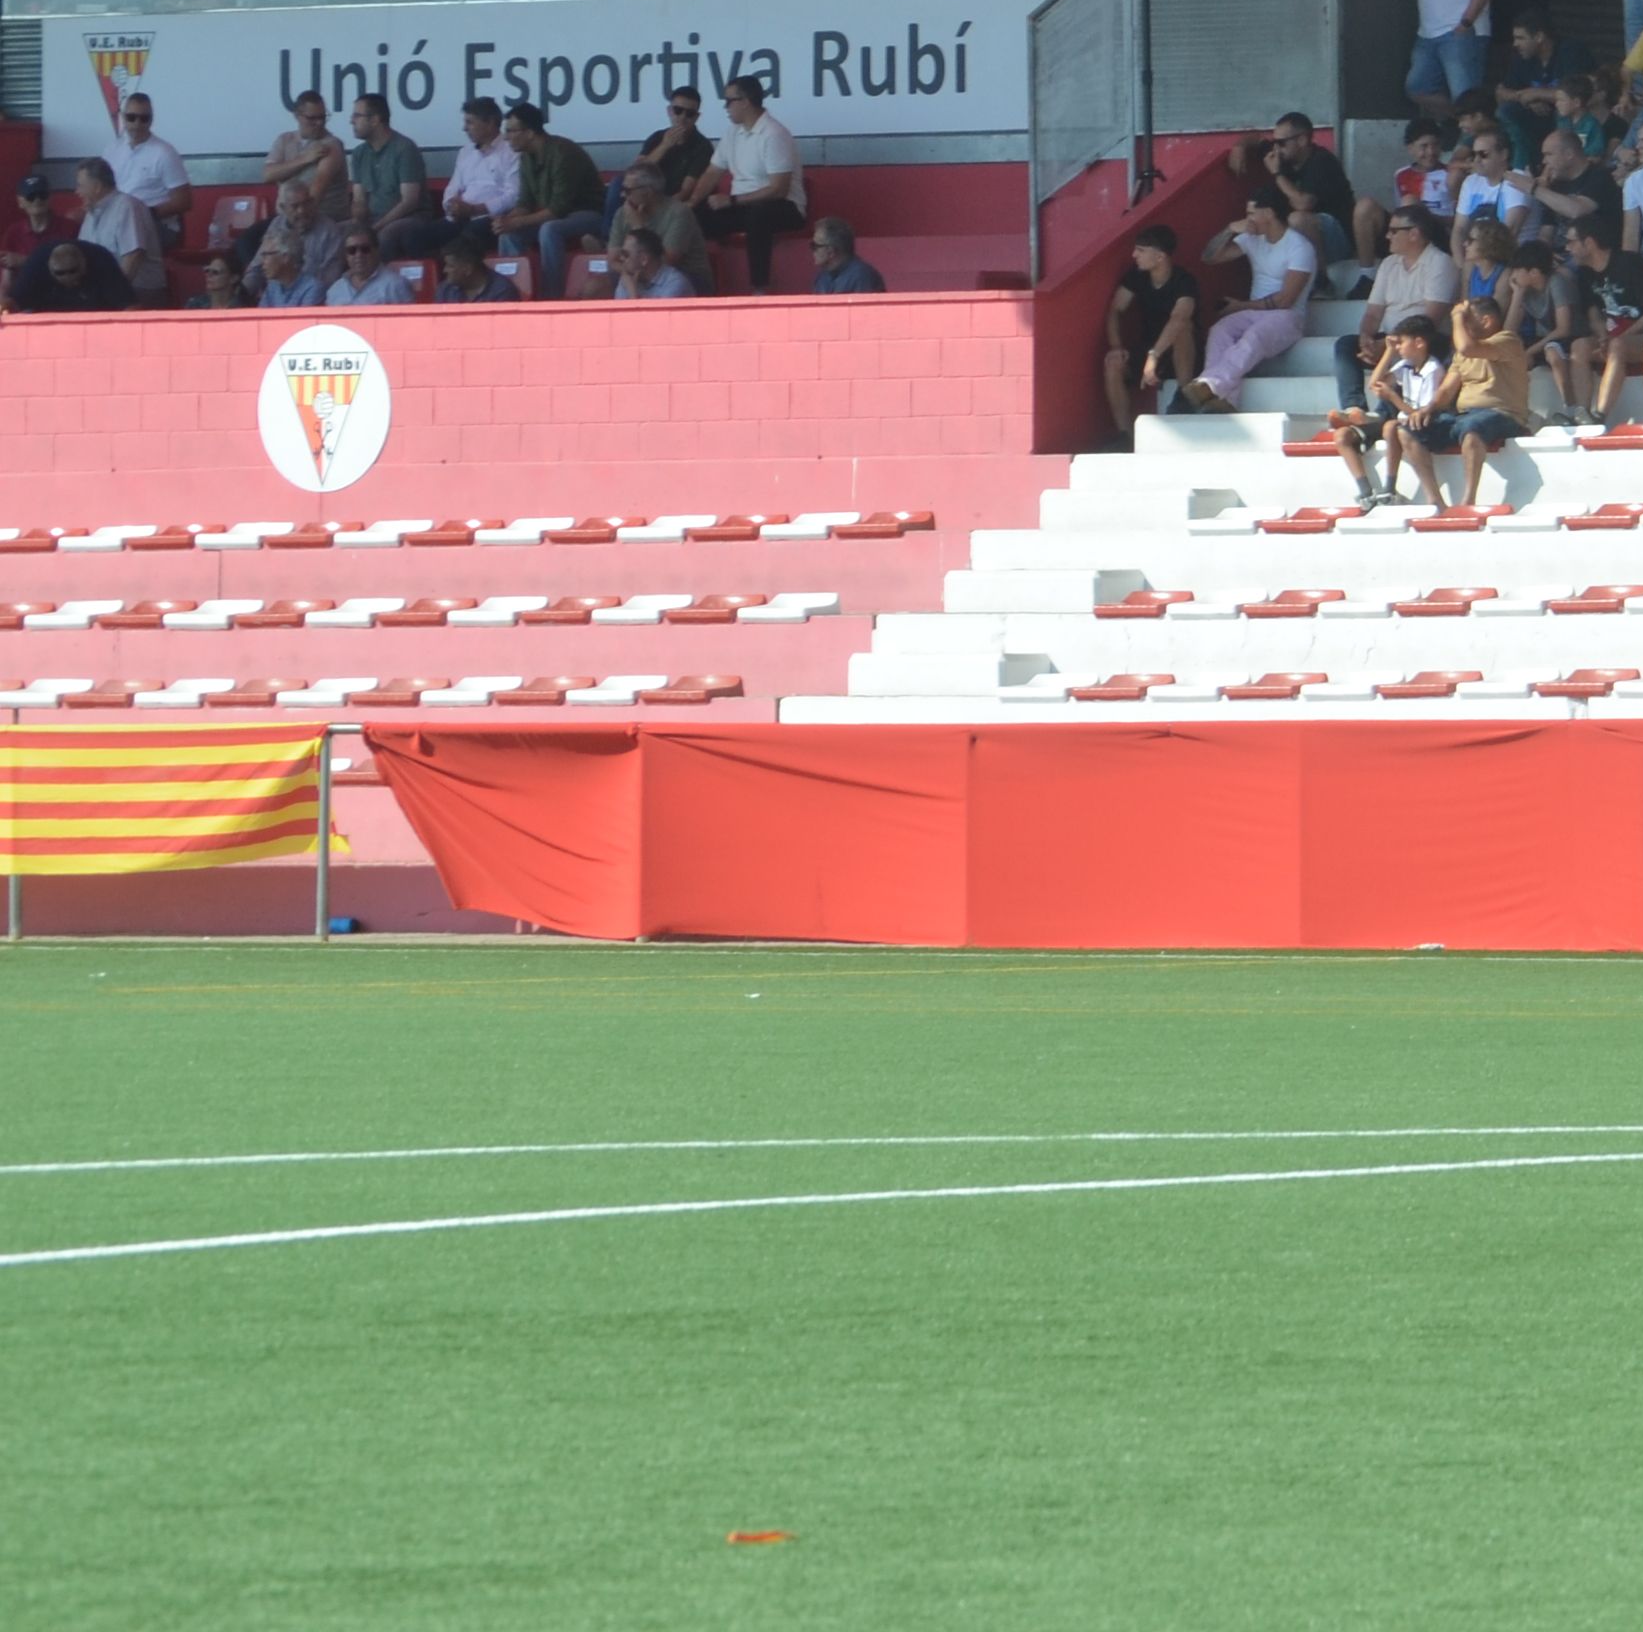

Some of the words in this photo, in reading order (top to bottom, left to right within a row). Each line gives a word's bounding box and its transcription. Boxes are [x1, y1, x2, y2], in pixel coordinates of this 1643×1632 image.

[279, 38, 435, 113] Unió
[464, 31, 782, 124] Esportiva
[812, 20, 973, 98] Rubí
[288, 357, 317, 371] U.E.
